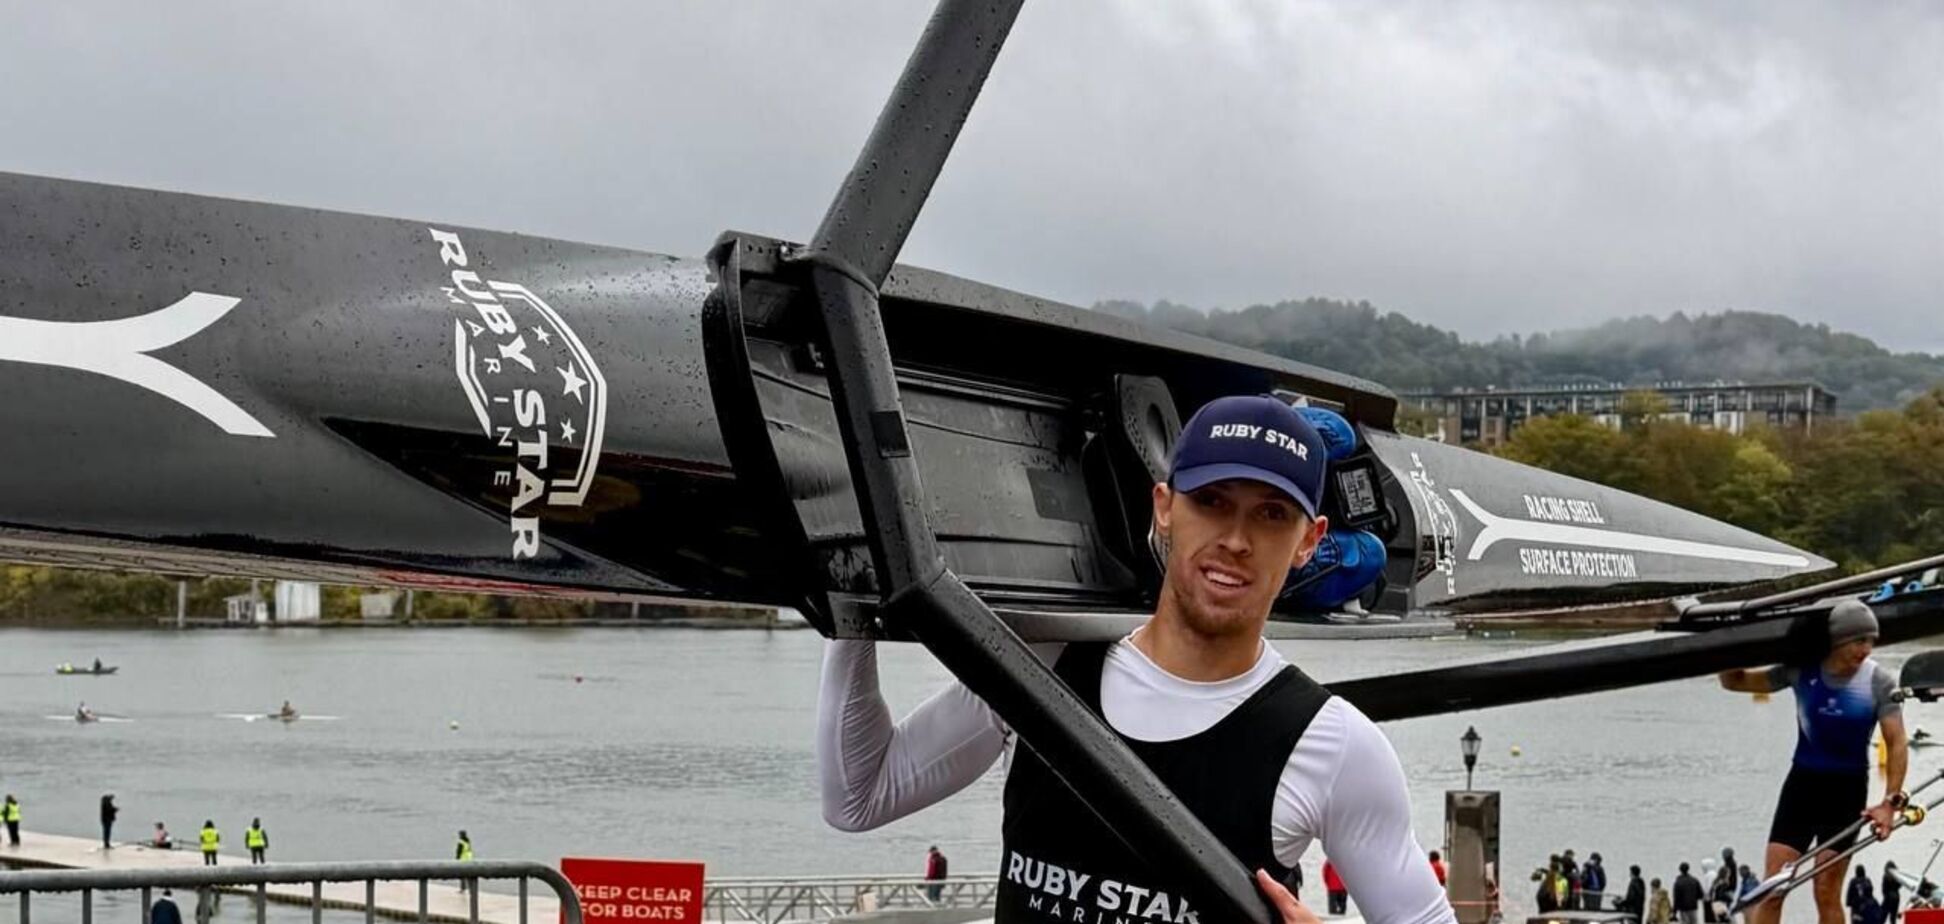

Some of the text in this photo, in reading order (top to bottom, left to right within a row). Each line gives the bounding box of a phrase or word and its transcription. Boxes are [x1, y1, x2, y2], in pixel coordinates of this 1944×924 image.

[428, 228, 549, 560] RUBY STAR
[440, 286, 511, 487] MARINE
[1209, 424, 1308, 461] RUBY STAR
[1523, 494, 1605, 524] RACING SHELL
[1519, 548, 1637, 577] SURFACE PROTECTION
[1007, 851, 1091, 901] RUBY
[573, 884, 692, 902] KEEP CLEAR
[621, 904, 685, 920] BOATS
[1029, 894, 1152, 924] MARI
